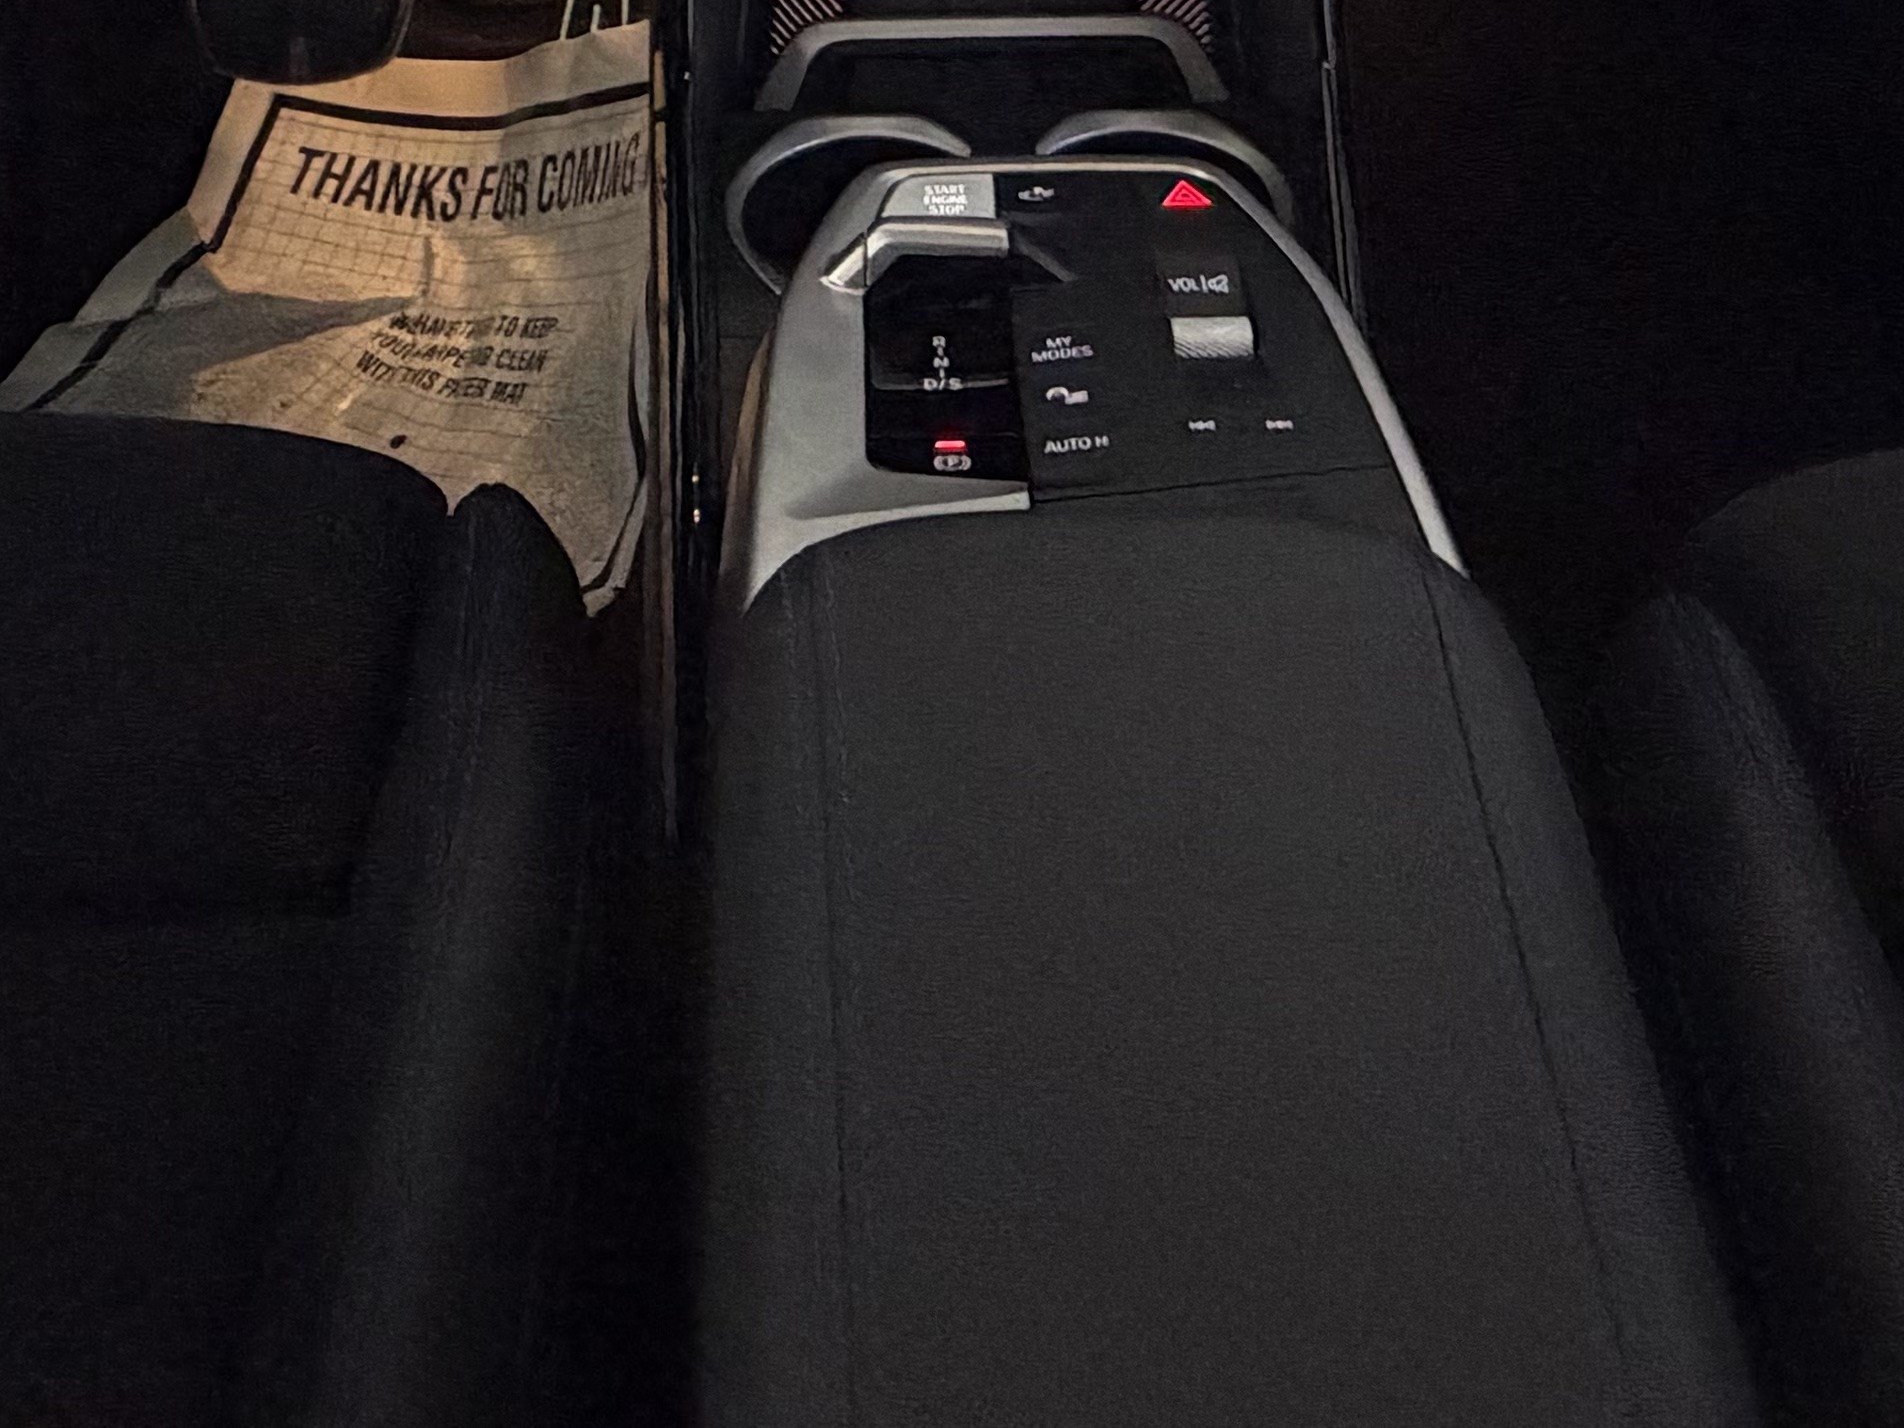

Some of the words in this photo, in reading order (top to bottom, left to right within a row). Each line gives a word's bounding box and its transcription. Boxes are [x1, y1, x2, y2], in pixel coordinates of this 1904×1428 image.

[290, 146, 469, 224] THANKS
[470, 157, 530, 222] FOR
[536, 130, 642, 214] COMING
[928, 204, 966, 216] STOP
[1167, 276, 1201, 294] VOL
[495, 314, 520, 338] TO
[1046, 336, 1073, 349] MY
[933, 356, 950, 370] N
[1031, 345, 1094, 364] MODES
[1044, 437, 1092, 454] AUTO
